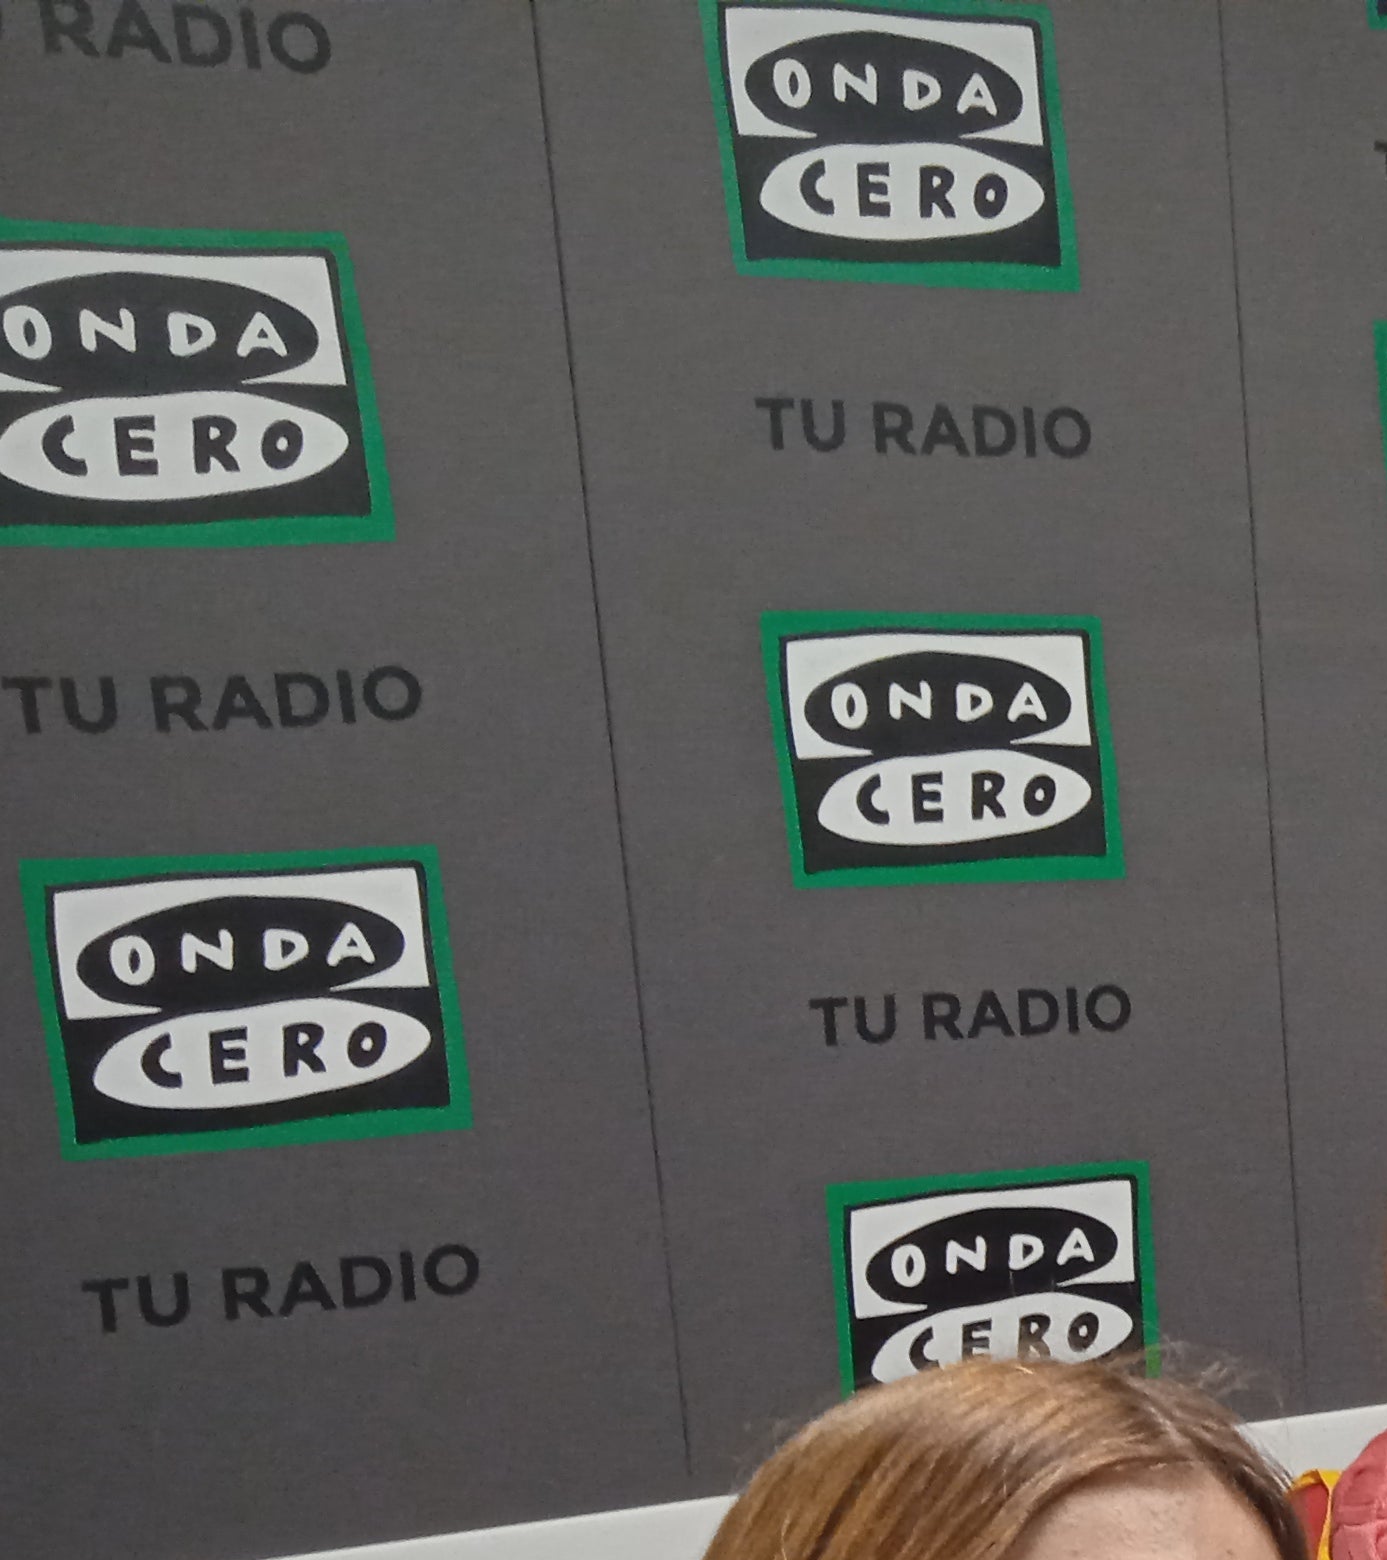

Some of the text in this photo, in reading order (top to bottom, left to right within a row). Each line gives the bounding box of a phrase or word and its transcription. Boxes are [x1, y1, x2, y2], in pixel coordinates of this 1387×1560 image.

[38, 0, 332, 73] RADIO
[772, 58, 998, 116] ONDA
[799, 160, 1009, 219] CERO
[2, 304, 288, 360] ONDA
[42, 414, 304, 477] CERO
[755, 397, 1092, 458] TU RADIO
[1, 665, 423, 734] TU RADIO
[830, 680, 1048, 730] ONDA
[856, 771, 1057, 825] CERO
[109, 922, 375, 986] ONDA
[809, 984, 1132, 1046] TU RADIO
[141, 1021, 388, 1089] CERO
[82, 1243, 480, 1333] TU RADIO
[890, 1229, 1095, 1286] ONDA
[909, 1311, 1099, 1372] CERO
